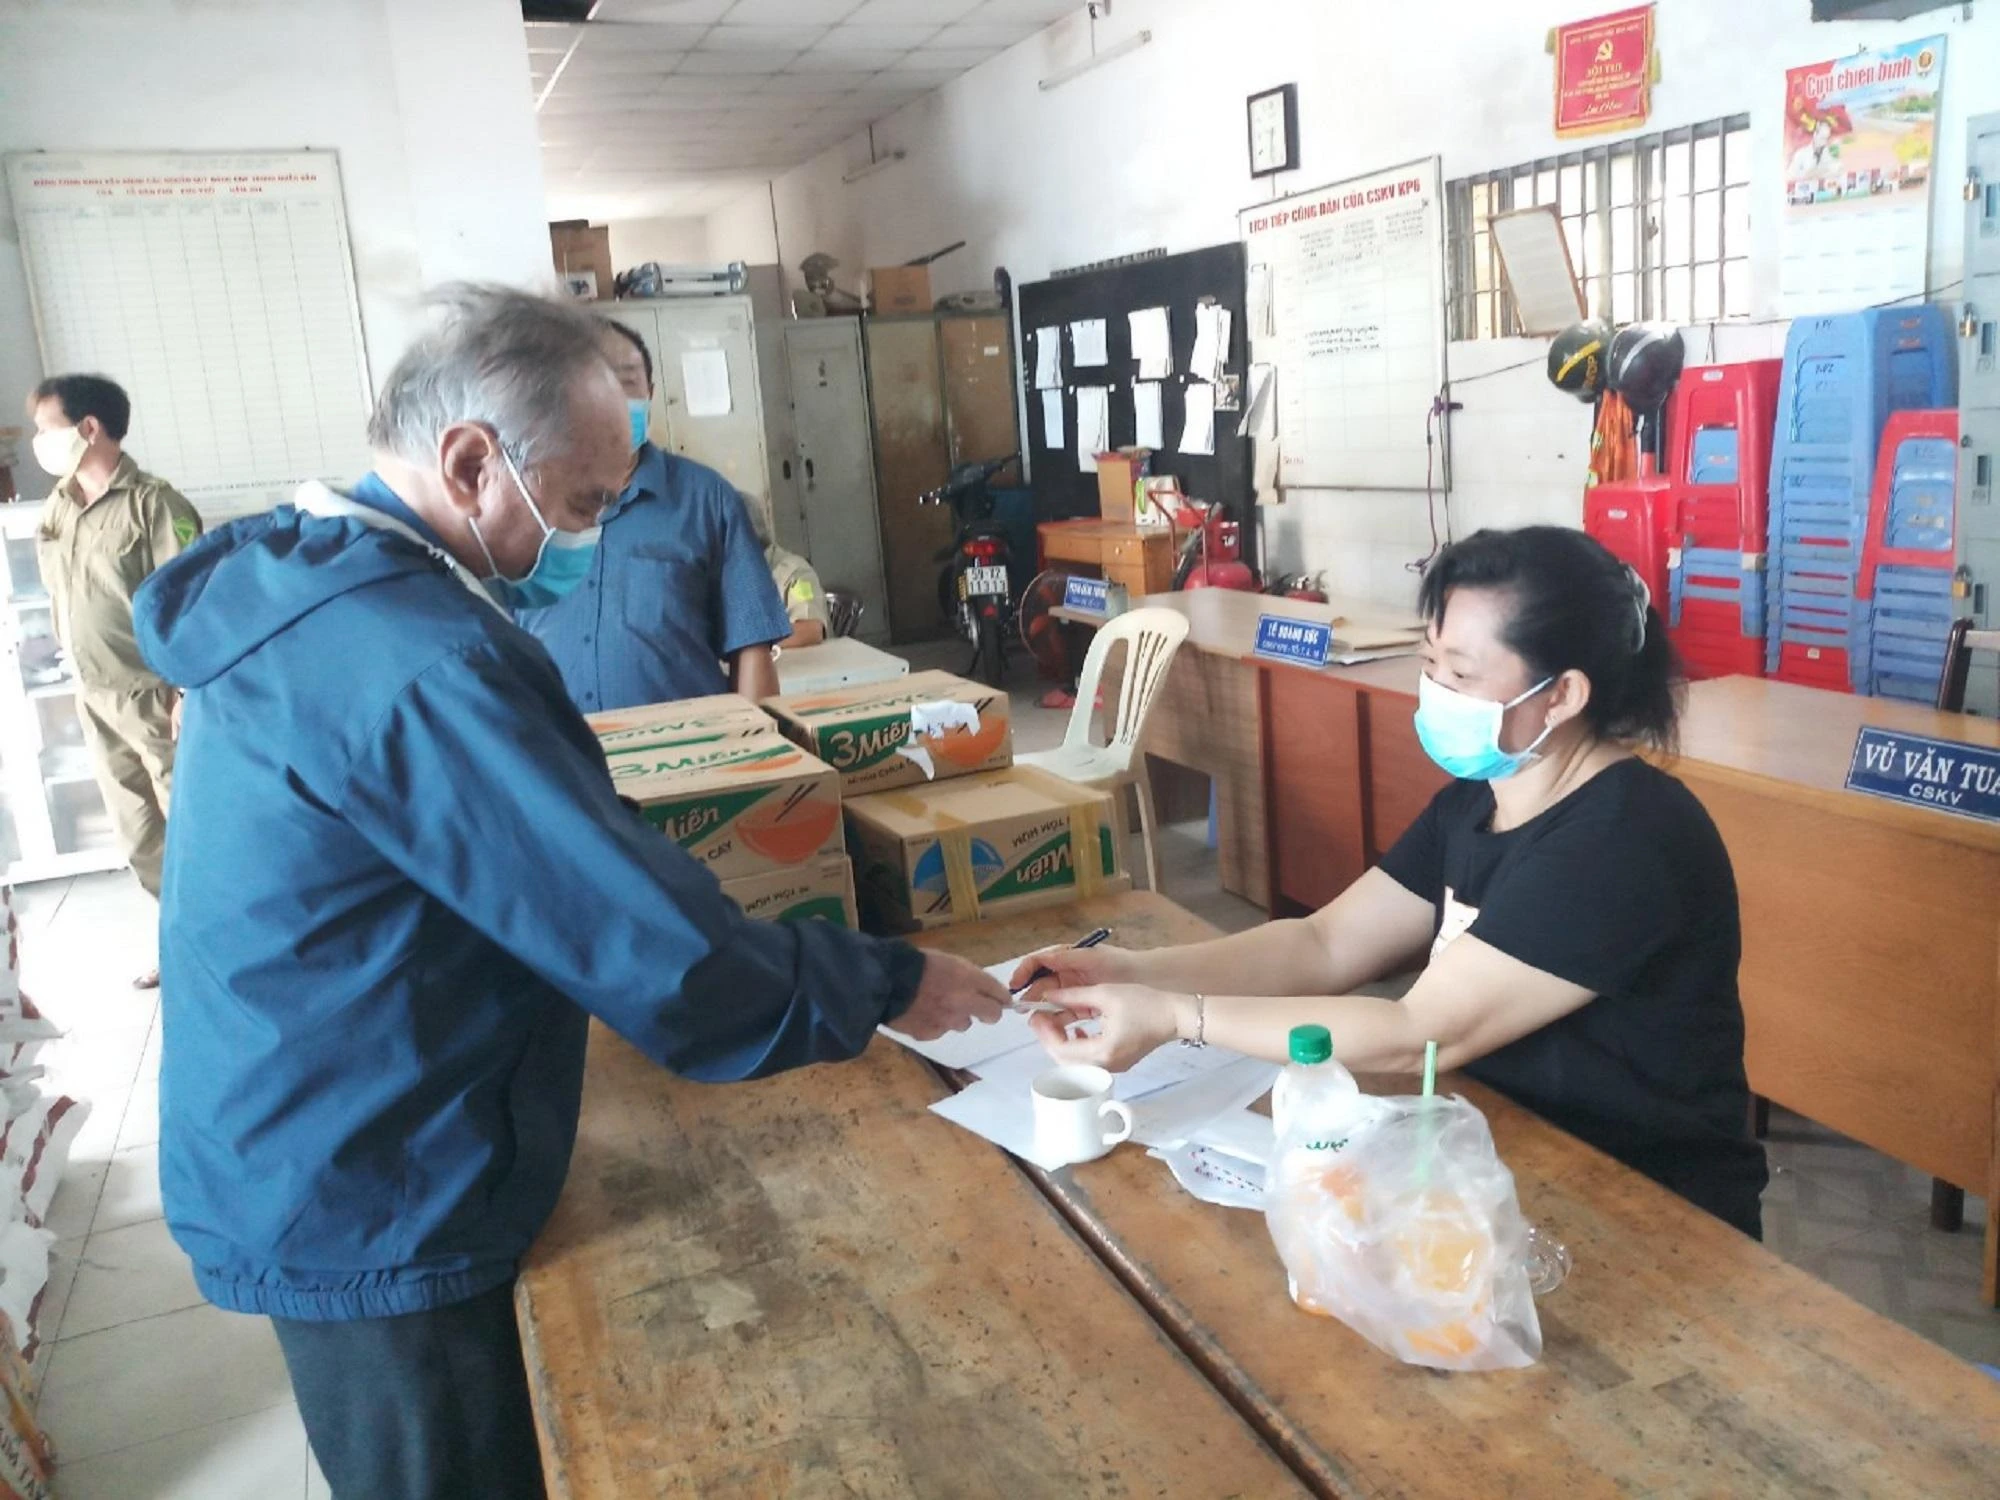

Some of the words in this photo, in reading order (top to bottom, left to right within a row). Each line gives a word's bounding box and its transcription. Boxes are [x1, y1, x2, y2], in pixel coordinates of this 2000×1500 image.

[1366, 182, 1396, 205] CSKV
[1864, 741, 1898, 772] VŨ
[1903, 746, 1955, 785] VĂN
[1908, 783, 1963, 806] CSKV
[707, 840, 732, 860] CAY
